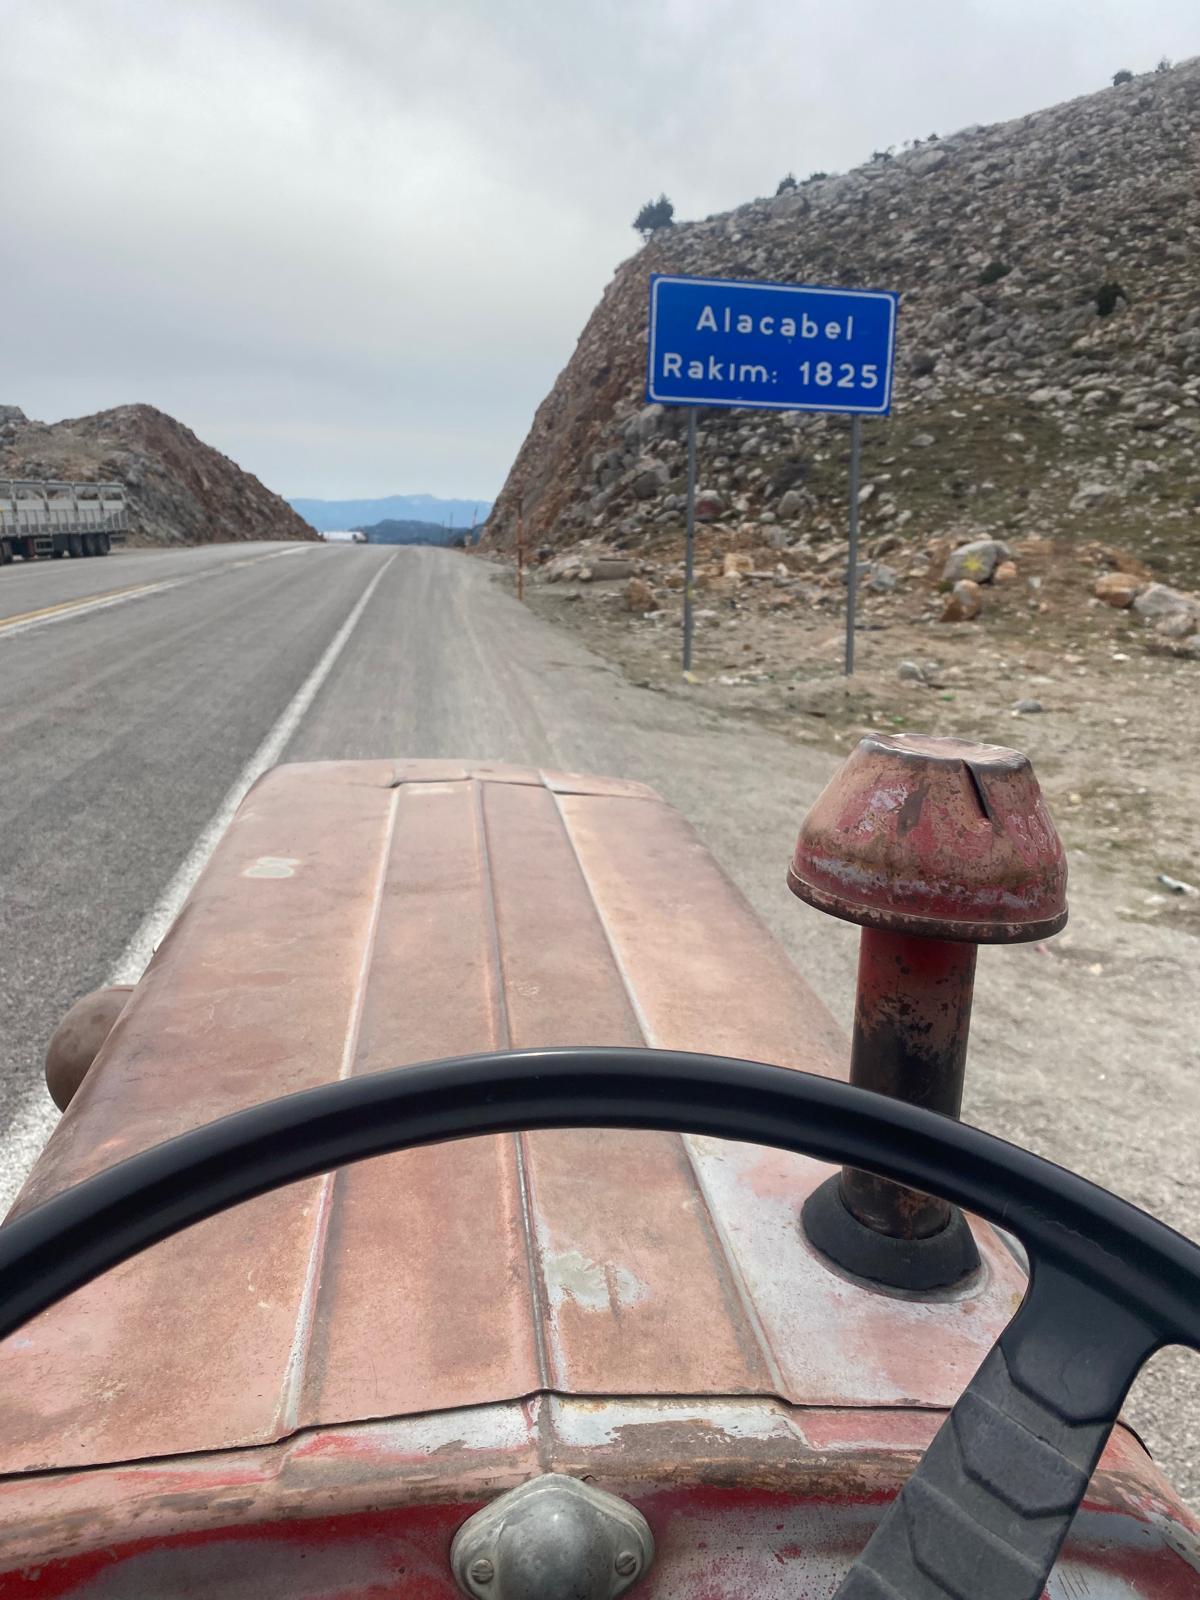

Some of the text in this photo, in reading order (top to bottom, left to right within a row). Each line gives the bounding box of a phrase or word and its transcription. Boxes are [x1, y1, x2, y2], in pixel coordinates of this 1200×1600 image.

[696, 305, 854, 341] Alacabel
[663, 353, 879, 389] Rakım: 1825
